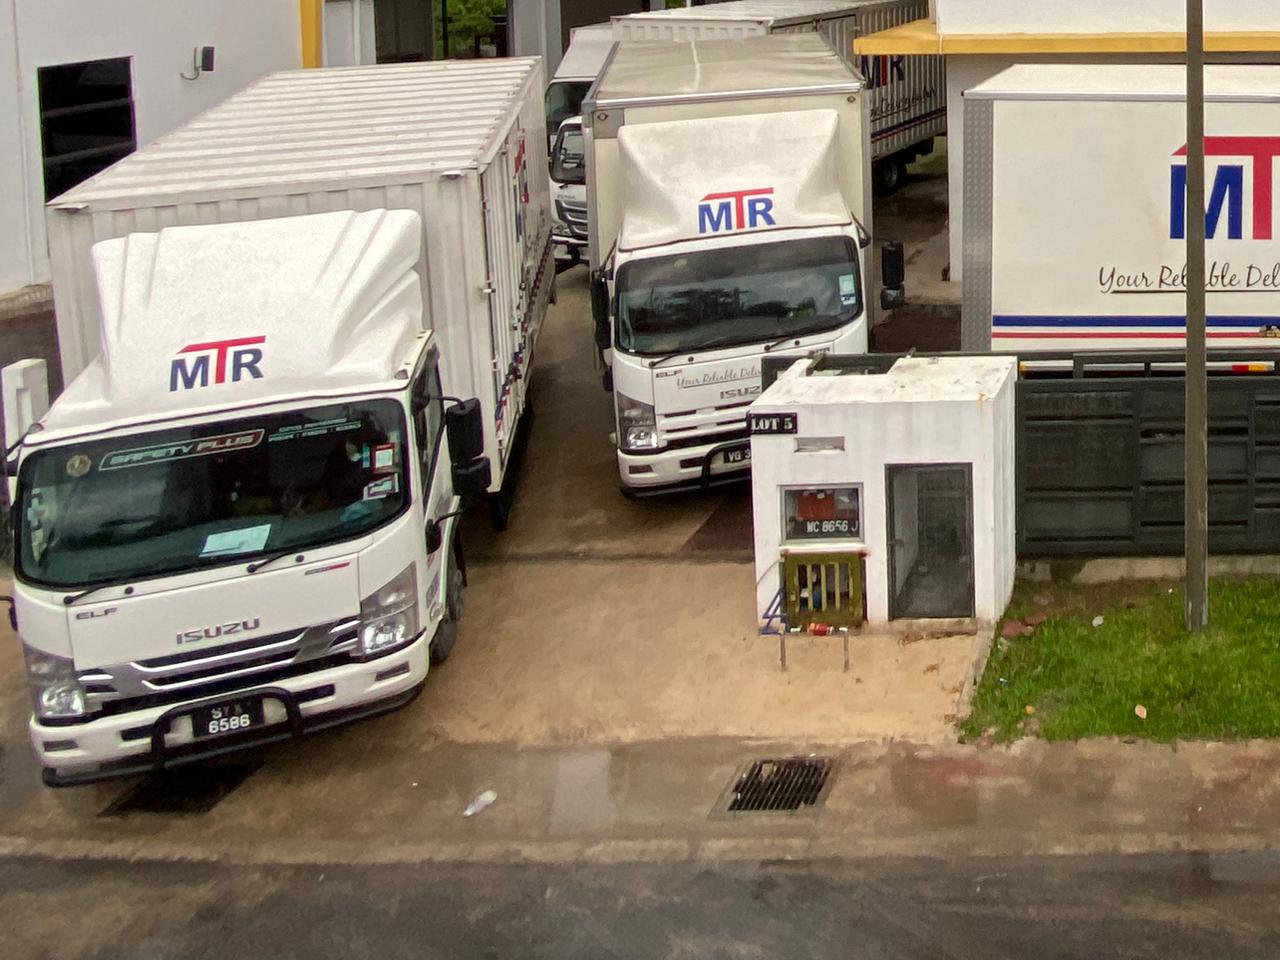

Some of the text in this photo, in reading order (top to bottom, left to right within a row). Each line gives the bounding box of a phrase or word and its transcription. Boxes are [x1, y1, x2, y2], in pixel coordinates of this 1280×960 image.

[698, 187, 777, 234] MTR
[1099, 266, 1154, 293] Your
[1158, 261, 1241, 288] Relble
[169, 335, 267, 393] MTR
[676, 377, 701, 388] Your
[702, 368, 738, 385] Reliable
[719, 385, 761, 400] ISUZ
[751, 417, 793, 431] LOT 5
[109, 433, 256, 466] SAFETY PLUS
[75, 607, 118, 620] ELF
[175, 617, 261, 645] ISUZU
